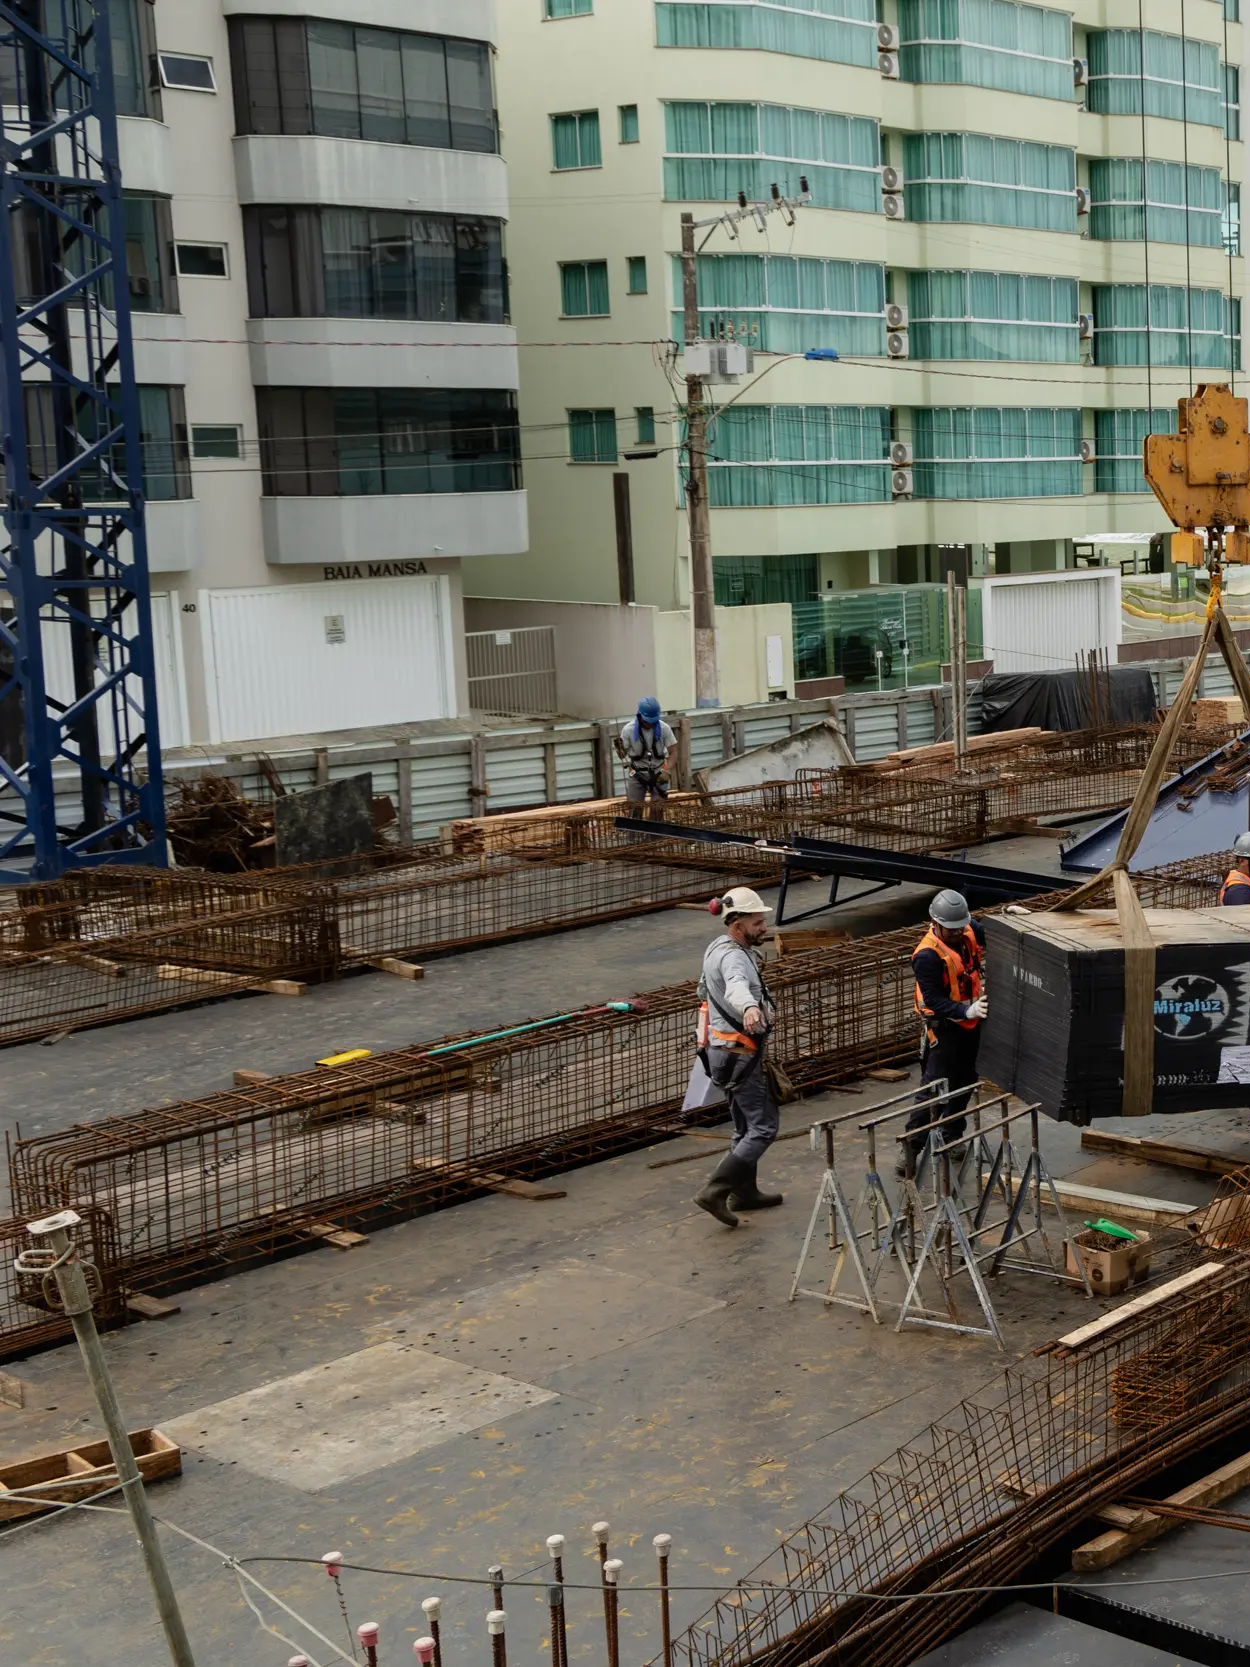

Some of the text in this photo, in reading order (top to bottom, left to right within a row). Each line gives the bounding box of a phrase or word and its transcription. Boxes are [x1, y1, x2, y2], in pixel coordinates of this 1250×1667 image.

[324, 561, 428, 580] BAIA MANSA
[182, 603, 196, 613] 40
[1153, 999, 1221, 1014] Miraluz
